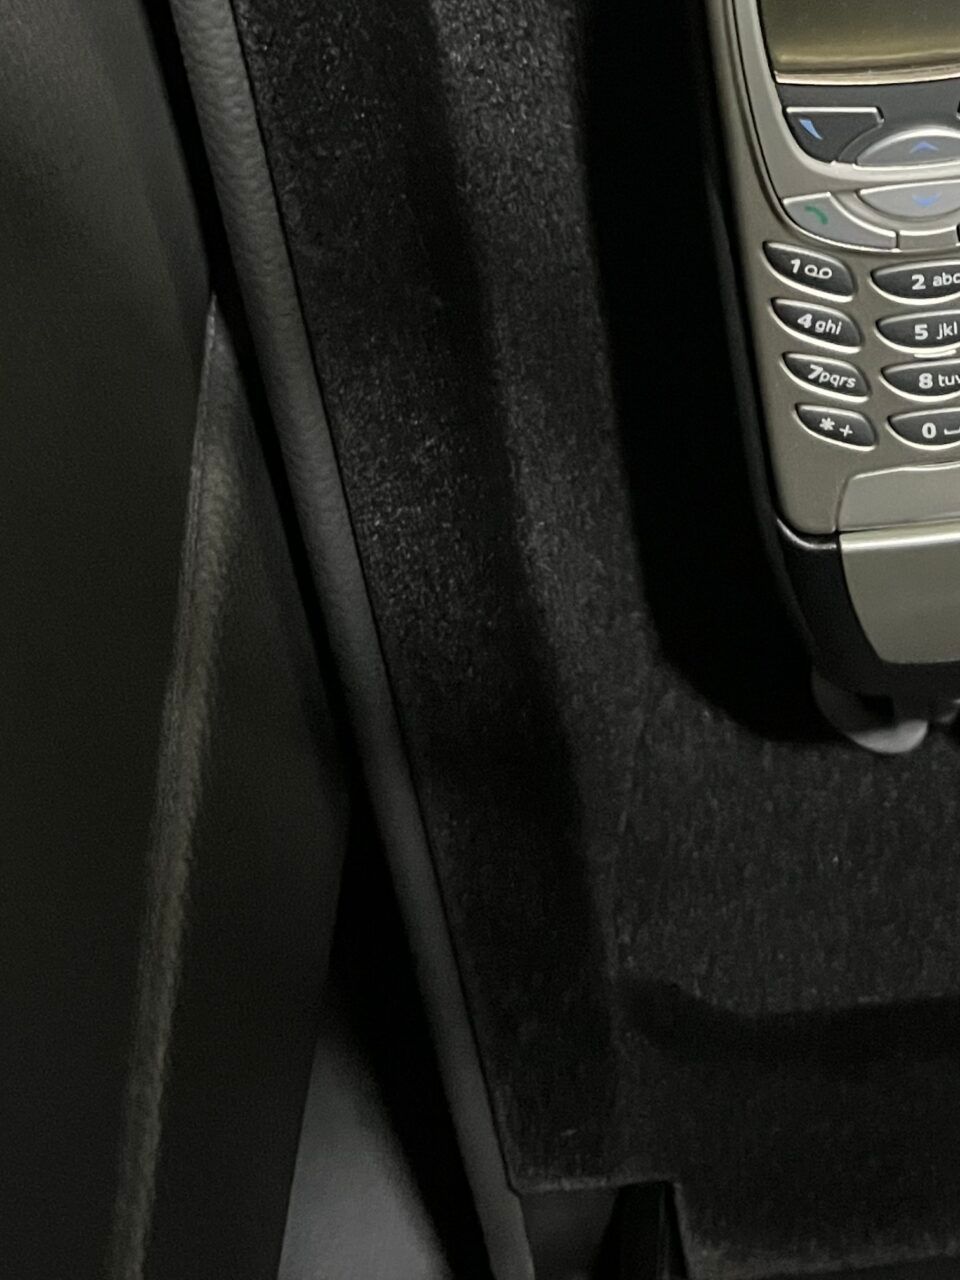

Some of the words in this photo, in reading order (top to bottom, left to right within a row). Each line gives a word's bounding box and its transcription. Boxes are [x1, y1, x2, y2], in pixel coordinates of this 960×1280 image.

[912, 274, 926, 290] 2
[914, 324, 928, 340] 5
[937, 321, 958, 340] jkl
[919, 373, 933, 389] 8
[922, 423, 936, 438] 0
